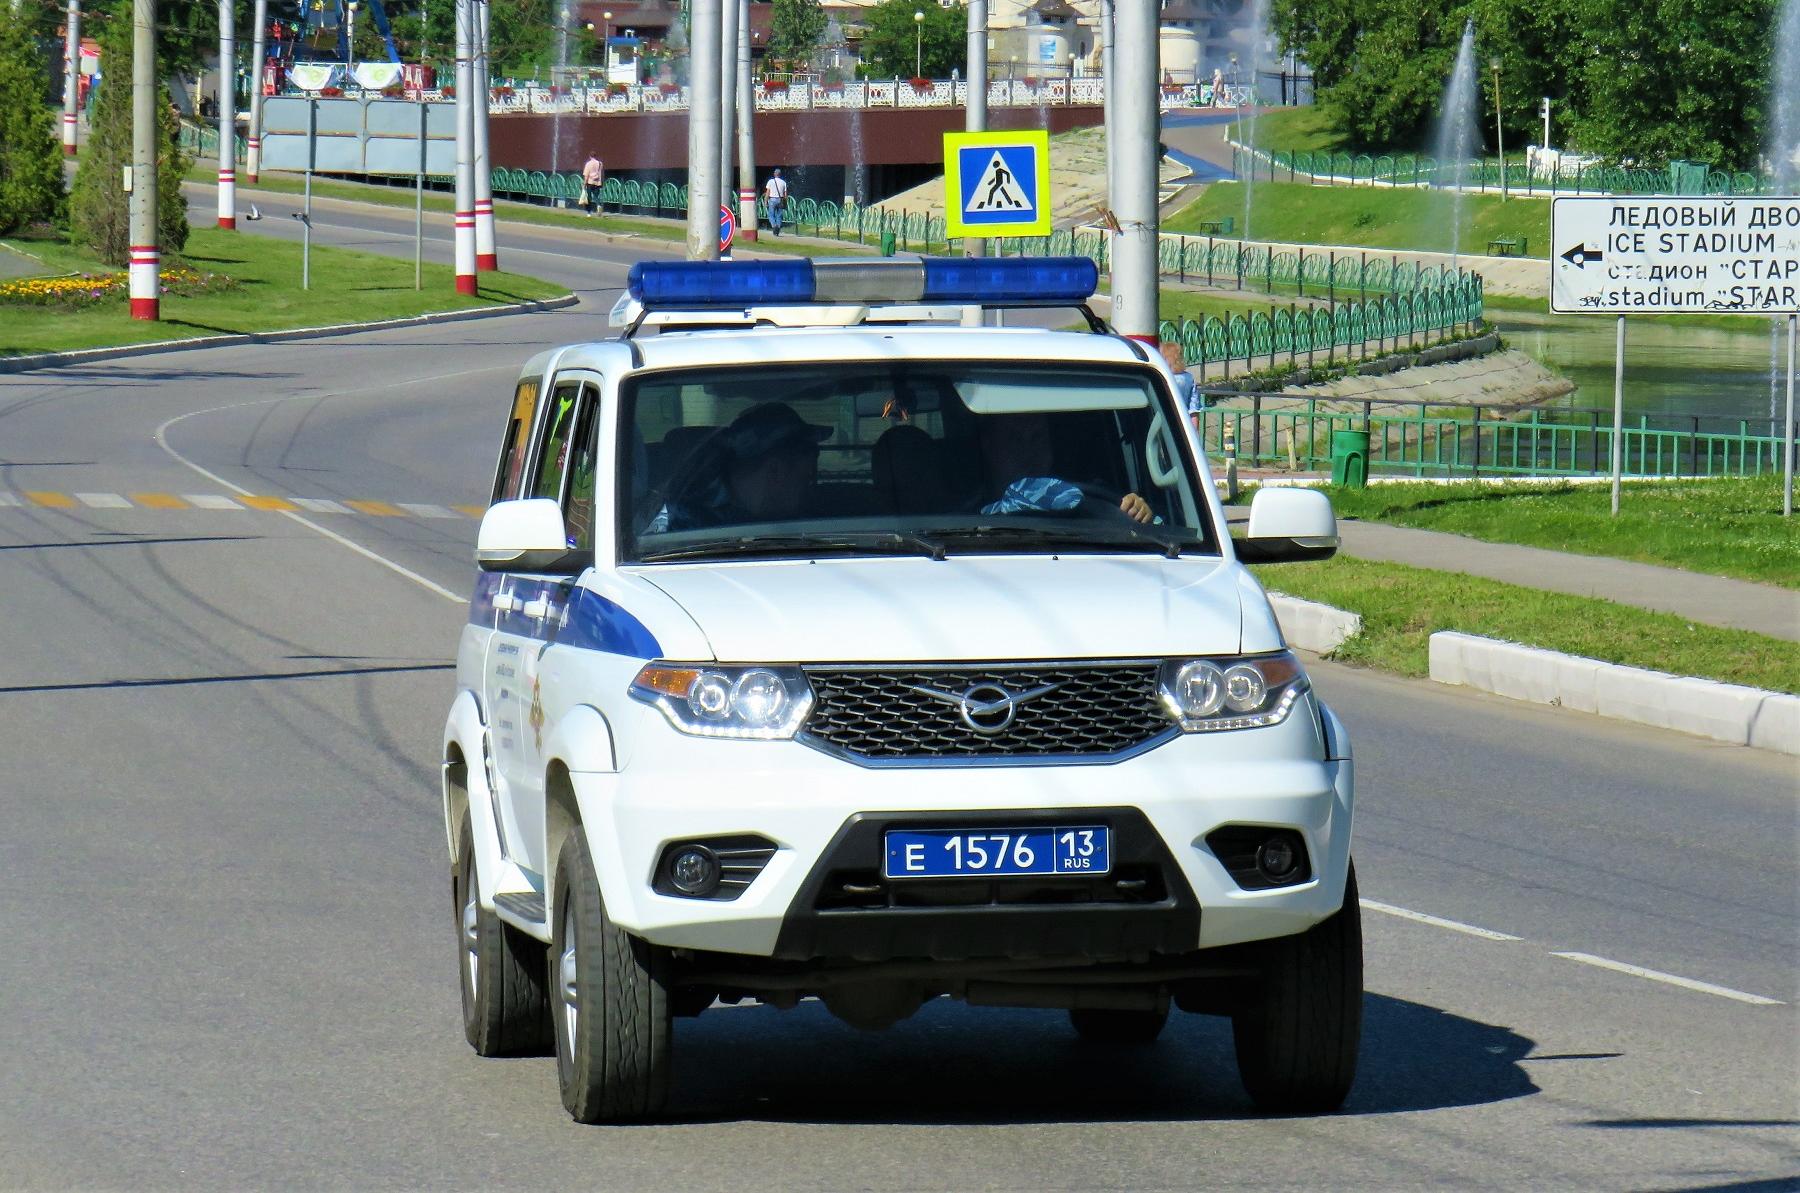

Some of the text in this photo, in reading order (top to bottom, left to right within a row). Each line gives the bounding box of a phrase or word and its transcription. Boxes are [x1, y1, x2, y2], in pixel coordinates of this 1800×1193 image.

[1609, 201, 1736, 229] ЛЕДОВЫЙ
[1608, 233, 1775, 253] ICE STADIUM
[1608, 286, 1705, 306] stadium
[944, 834, 1035, 869] 1576
[1060, 830, 1095, 857] 13
[1064, 858, 1091, 869] RUS
